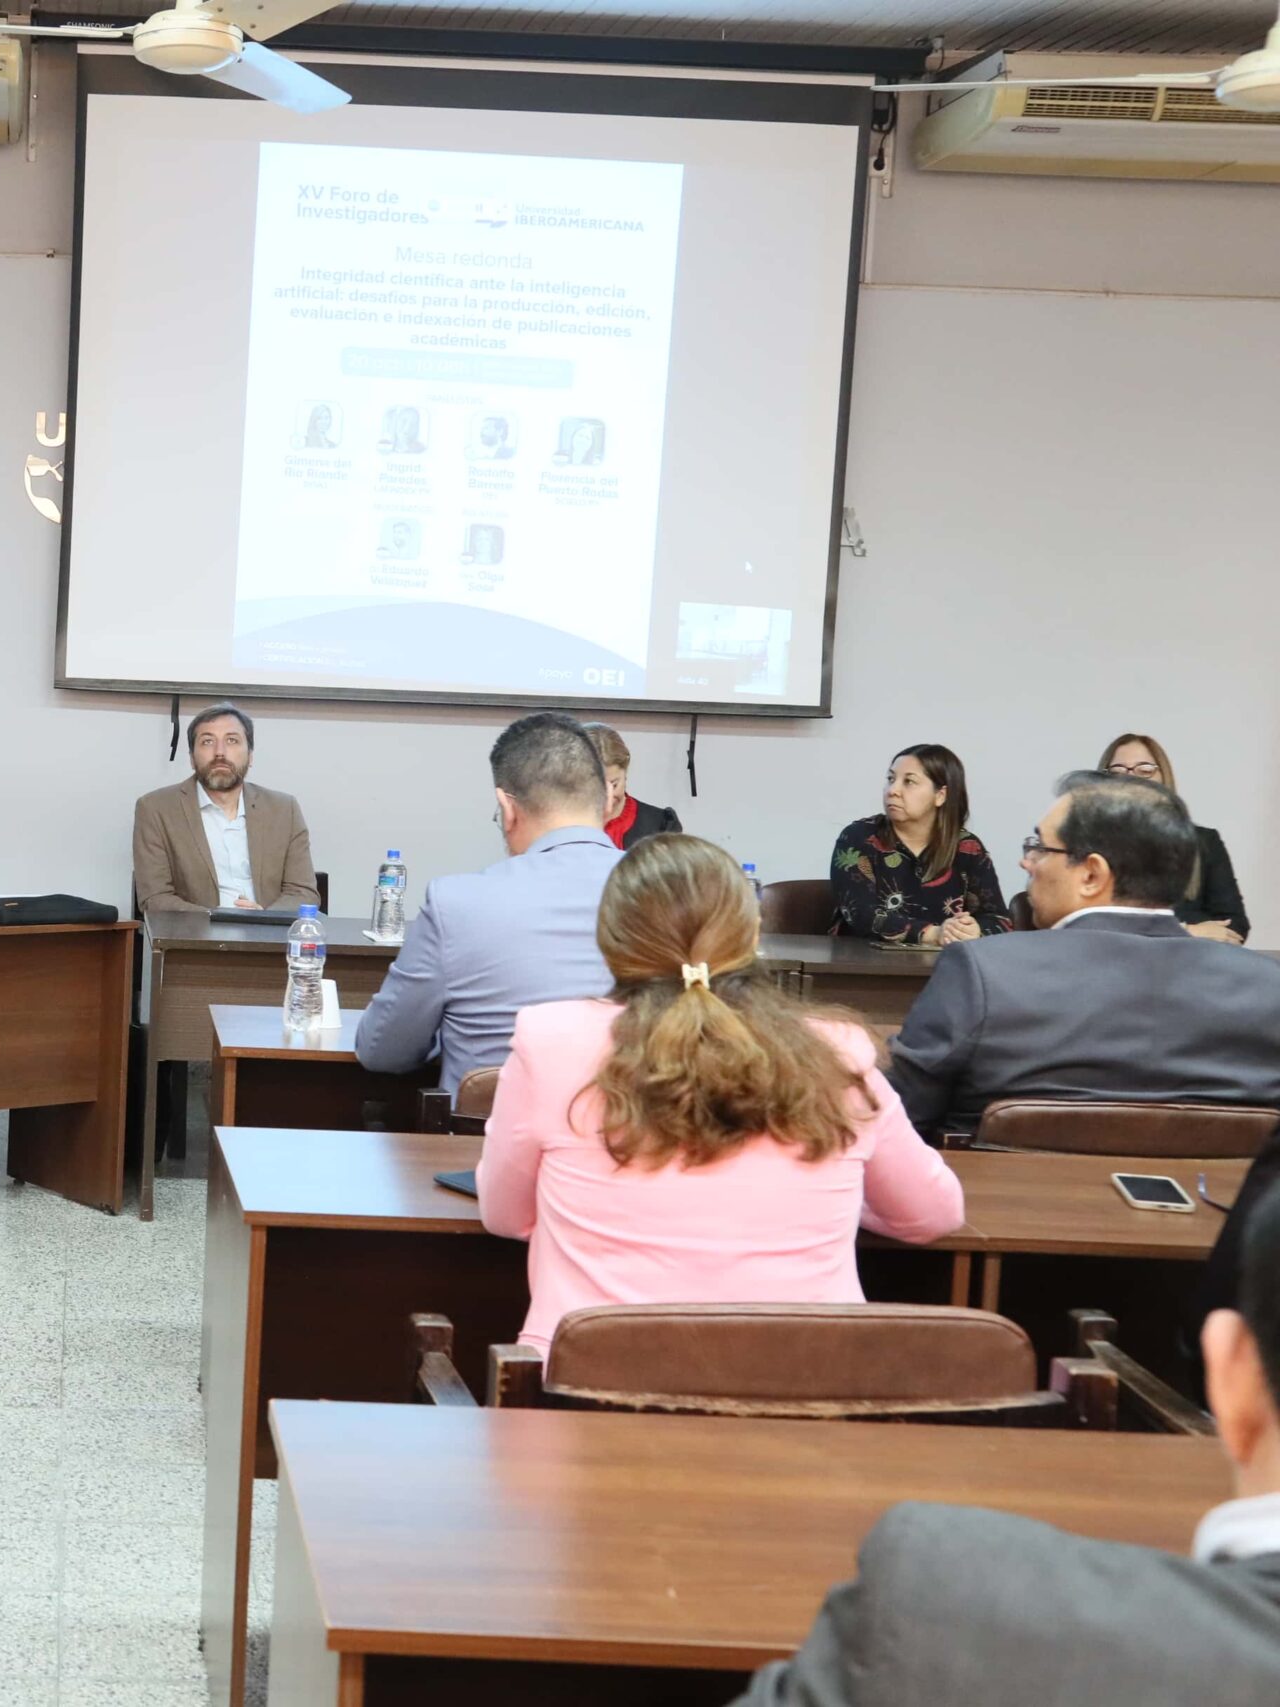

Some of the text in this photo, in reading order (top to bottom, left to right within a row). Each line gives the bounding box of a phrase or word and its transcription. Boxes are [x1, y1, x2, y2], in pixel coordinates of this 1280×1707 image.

[297, 184, 400, 204] XV Foro de
[296, 202, 429, 224] Investigadores
[515, 214, 645, 232] IBEROAMERICANA
[395, 246, 532, 270] Mesa redonda
[300, 265, 385, 285] Integridad
[470, 277, 506, 291] ante
[510, 278, 524, 293] la
[529, 279, 626, 299] inteligencia
[274, 285, 344, 302] artificial:
[421, 294, 459, 309] para
[464, 294, 478, 309] la
[289, 304, 632, 337] evaluación e indexación de publicaciones
[583, 667, 625, 687] OEI
